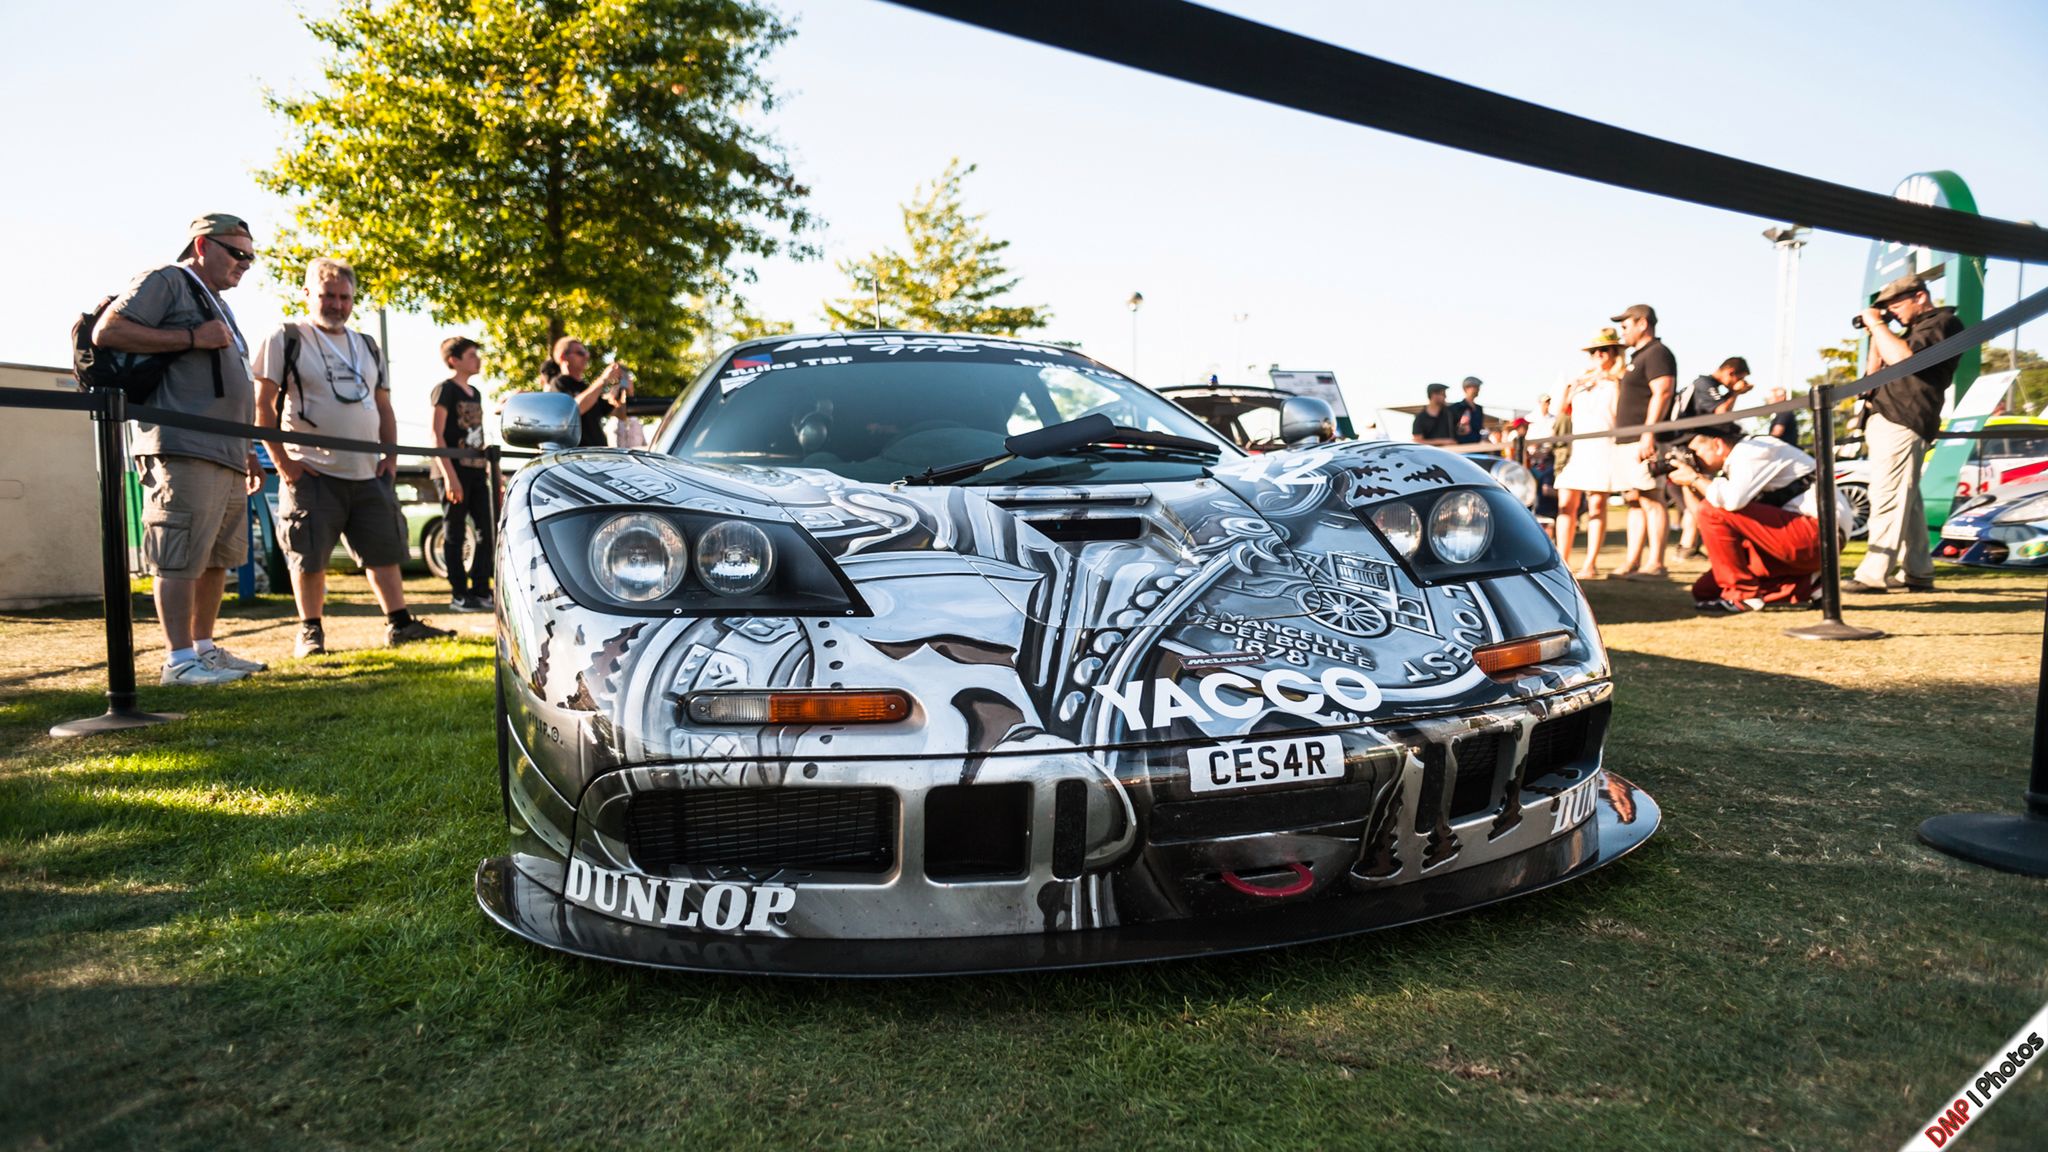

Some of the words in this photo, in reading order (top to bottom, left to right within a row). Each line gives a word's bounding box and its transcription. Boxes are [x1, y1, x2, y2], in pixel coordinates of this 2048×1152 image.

[1187, 655, 1260, 666] McLaren
[1234, 637, 1308, 665] 1878
[1275, 633, 1375, 671] BOLLEE
[1092, 667, 1382, 731] YACCO
[1208, 741, 1327, 786] CES4R
[566, 856, 797, 932] DUNLOP
